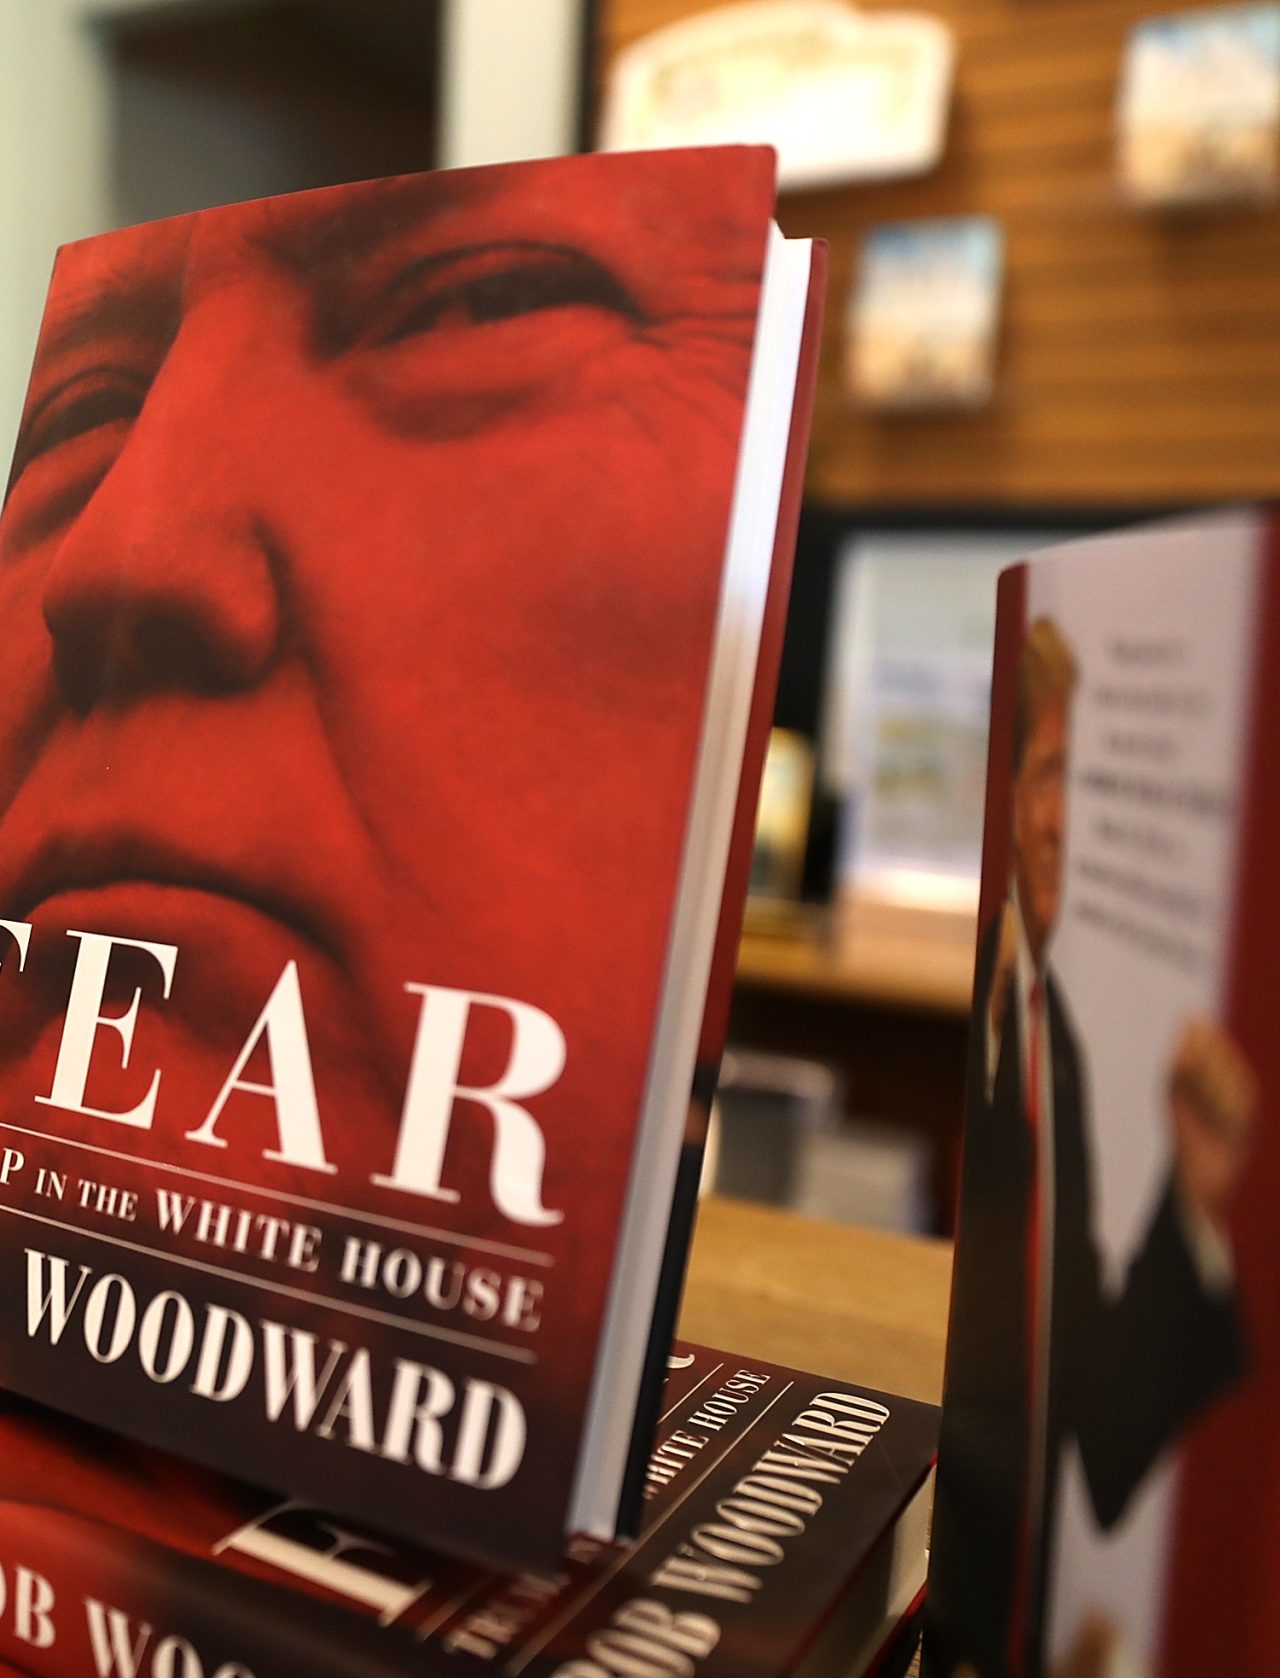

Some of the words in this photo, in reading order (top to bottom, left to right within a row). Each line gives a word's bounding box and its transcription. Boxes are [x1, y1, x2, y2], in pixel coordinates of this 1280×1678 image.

[34, 1167, 69, 1201] IN
[77, 1178, 139, 1223] THE
[155, 1187, 323, 1273] WHITE
[339, 1235, 545, 1333] HOUSE
[24, 1246, 528, 1491] WOODWARD
[686, 1368, 771, 1432] HOUSE
[546, 1598, 721, 1678] OB
[650, 1390, 891, 1604] WOODWARD
[84, 1594, 258, 1678] WO
